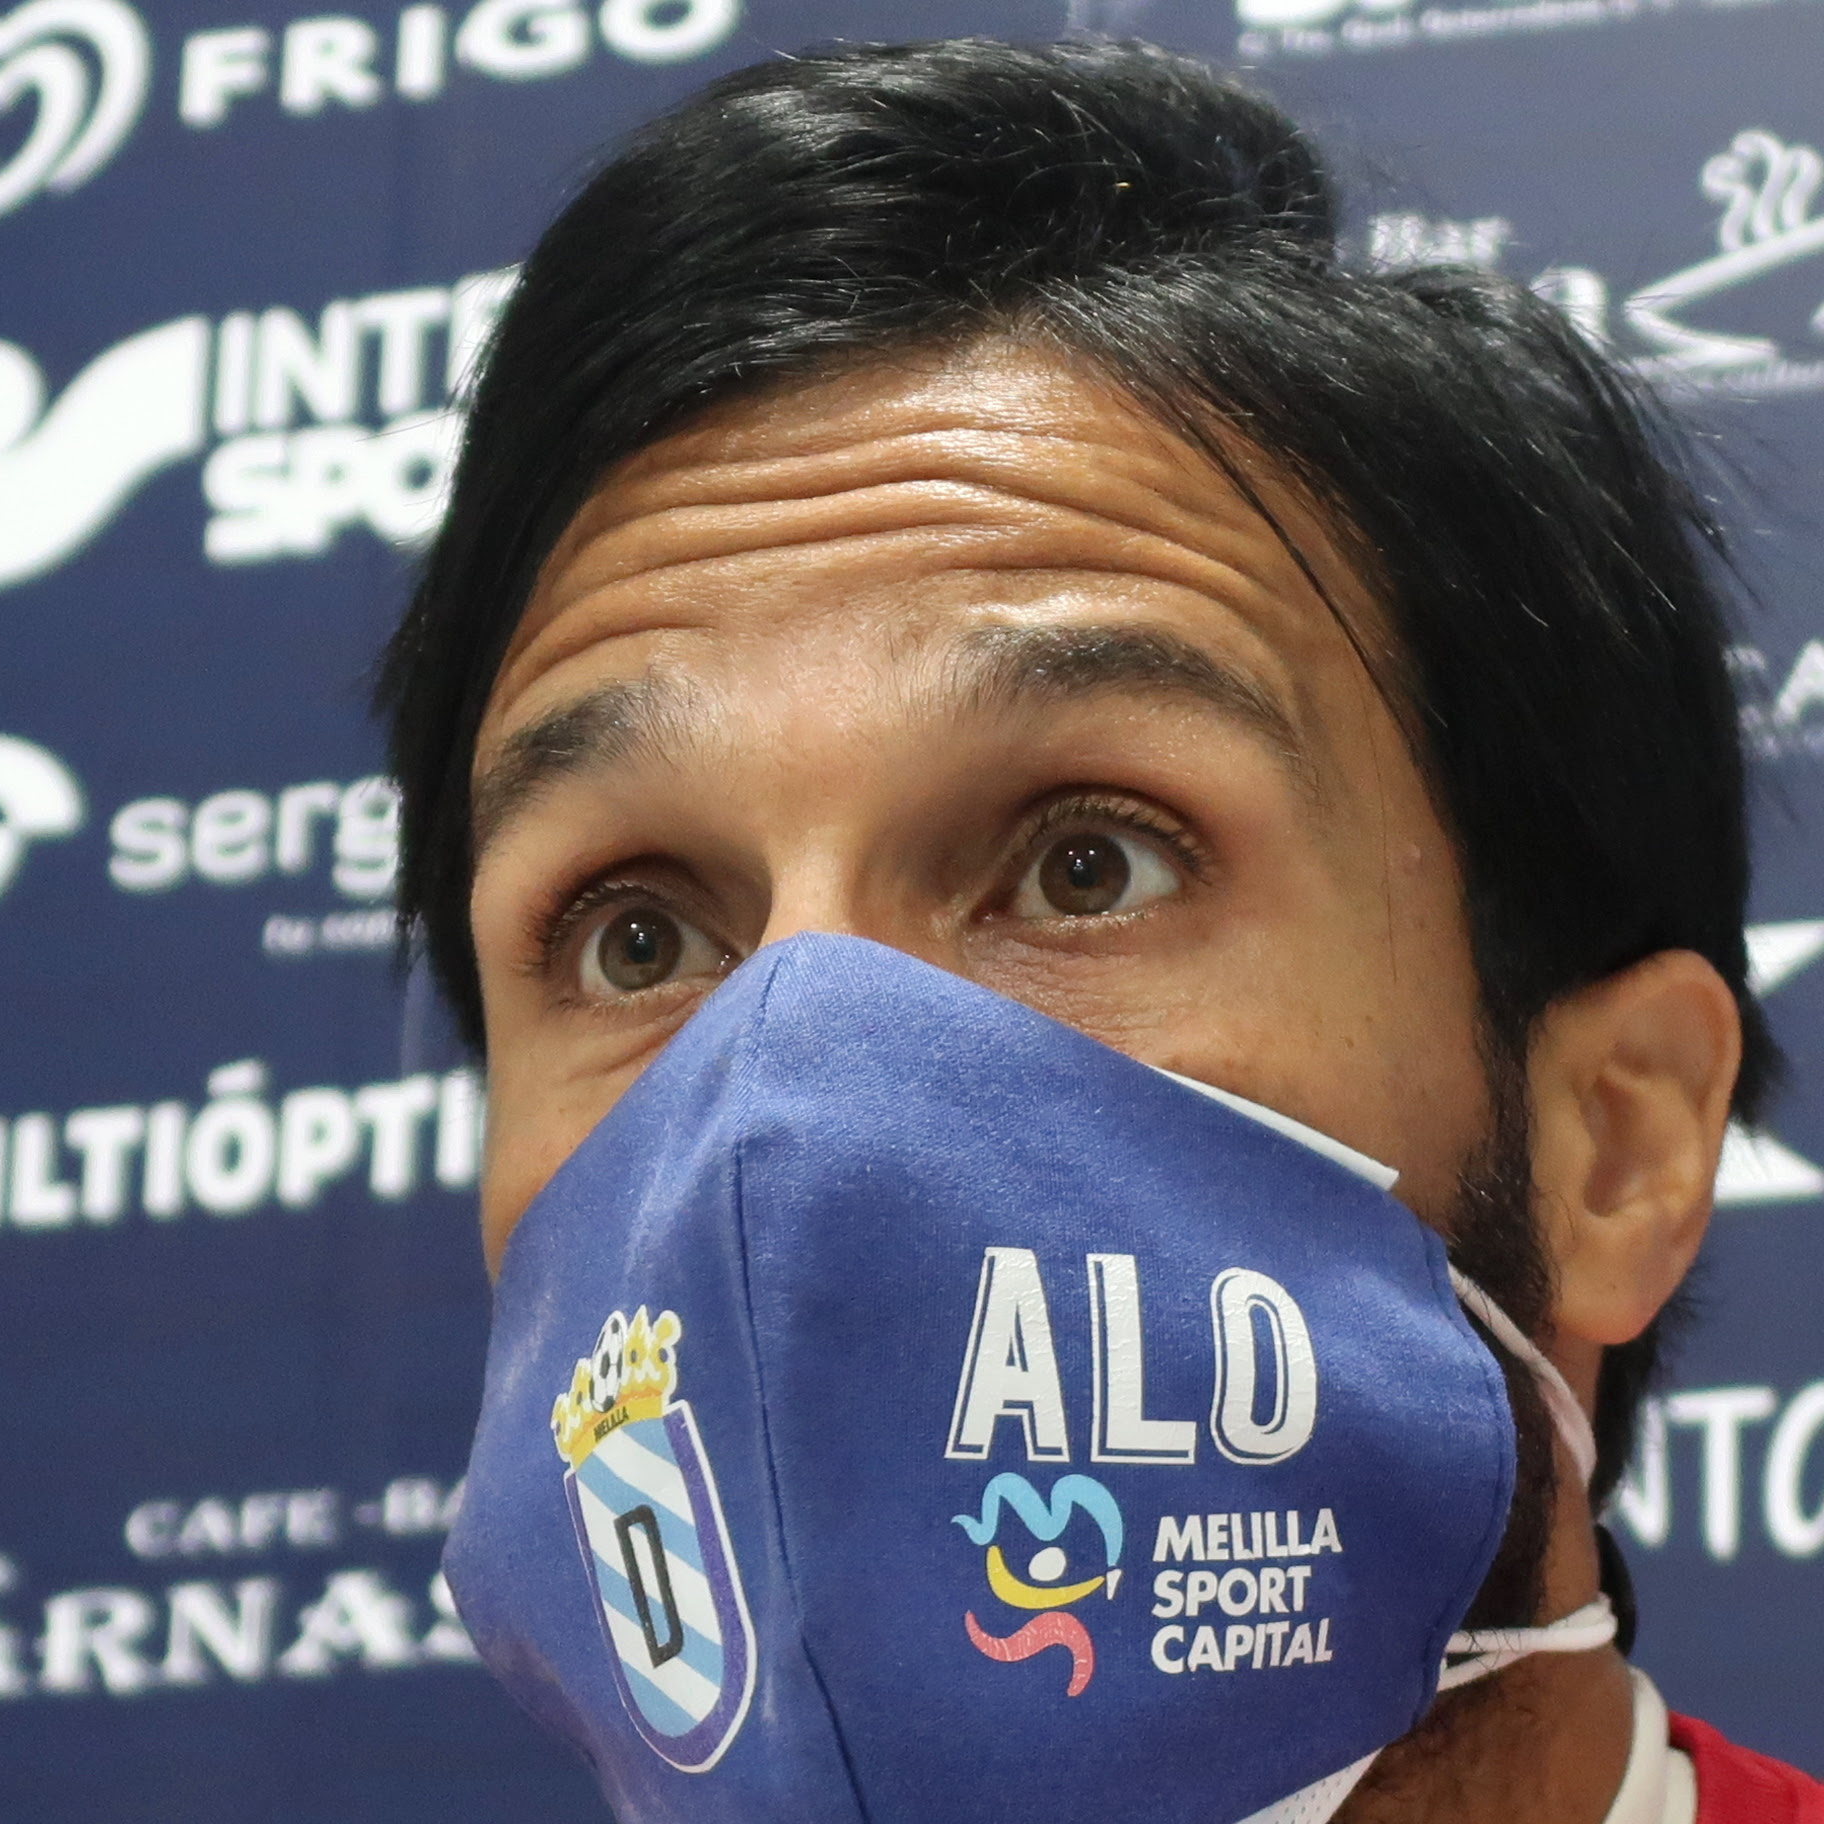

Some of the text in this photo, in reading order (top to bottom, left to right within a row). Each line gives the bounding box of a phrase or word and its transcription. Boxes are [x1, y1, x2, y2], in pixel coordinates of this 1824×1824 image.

[178, 0, 742, 128] FRIGO
[944, 1245, 1318, 1466] ALO
[592, 1405, 630, 1443] MELILLA
[124, 1488, 344, 1560] CAFE
[1151, 1508, 1344, 1563] MELILLA
[614, 1503, 685, 1669] D
[1151, 1564, 1312, 1620] SPORT
[1150, 1619, 1335, 1675] CAPITAL
